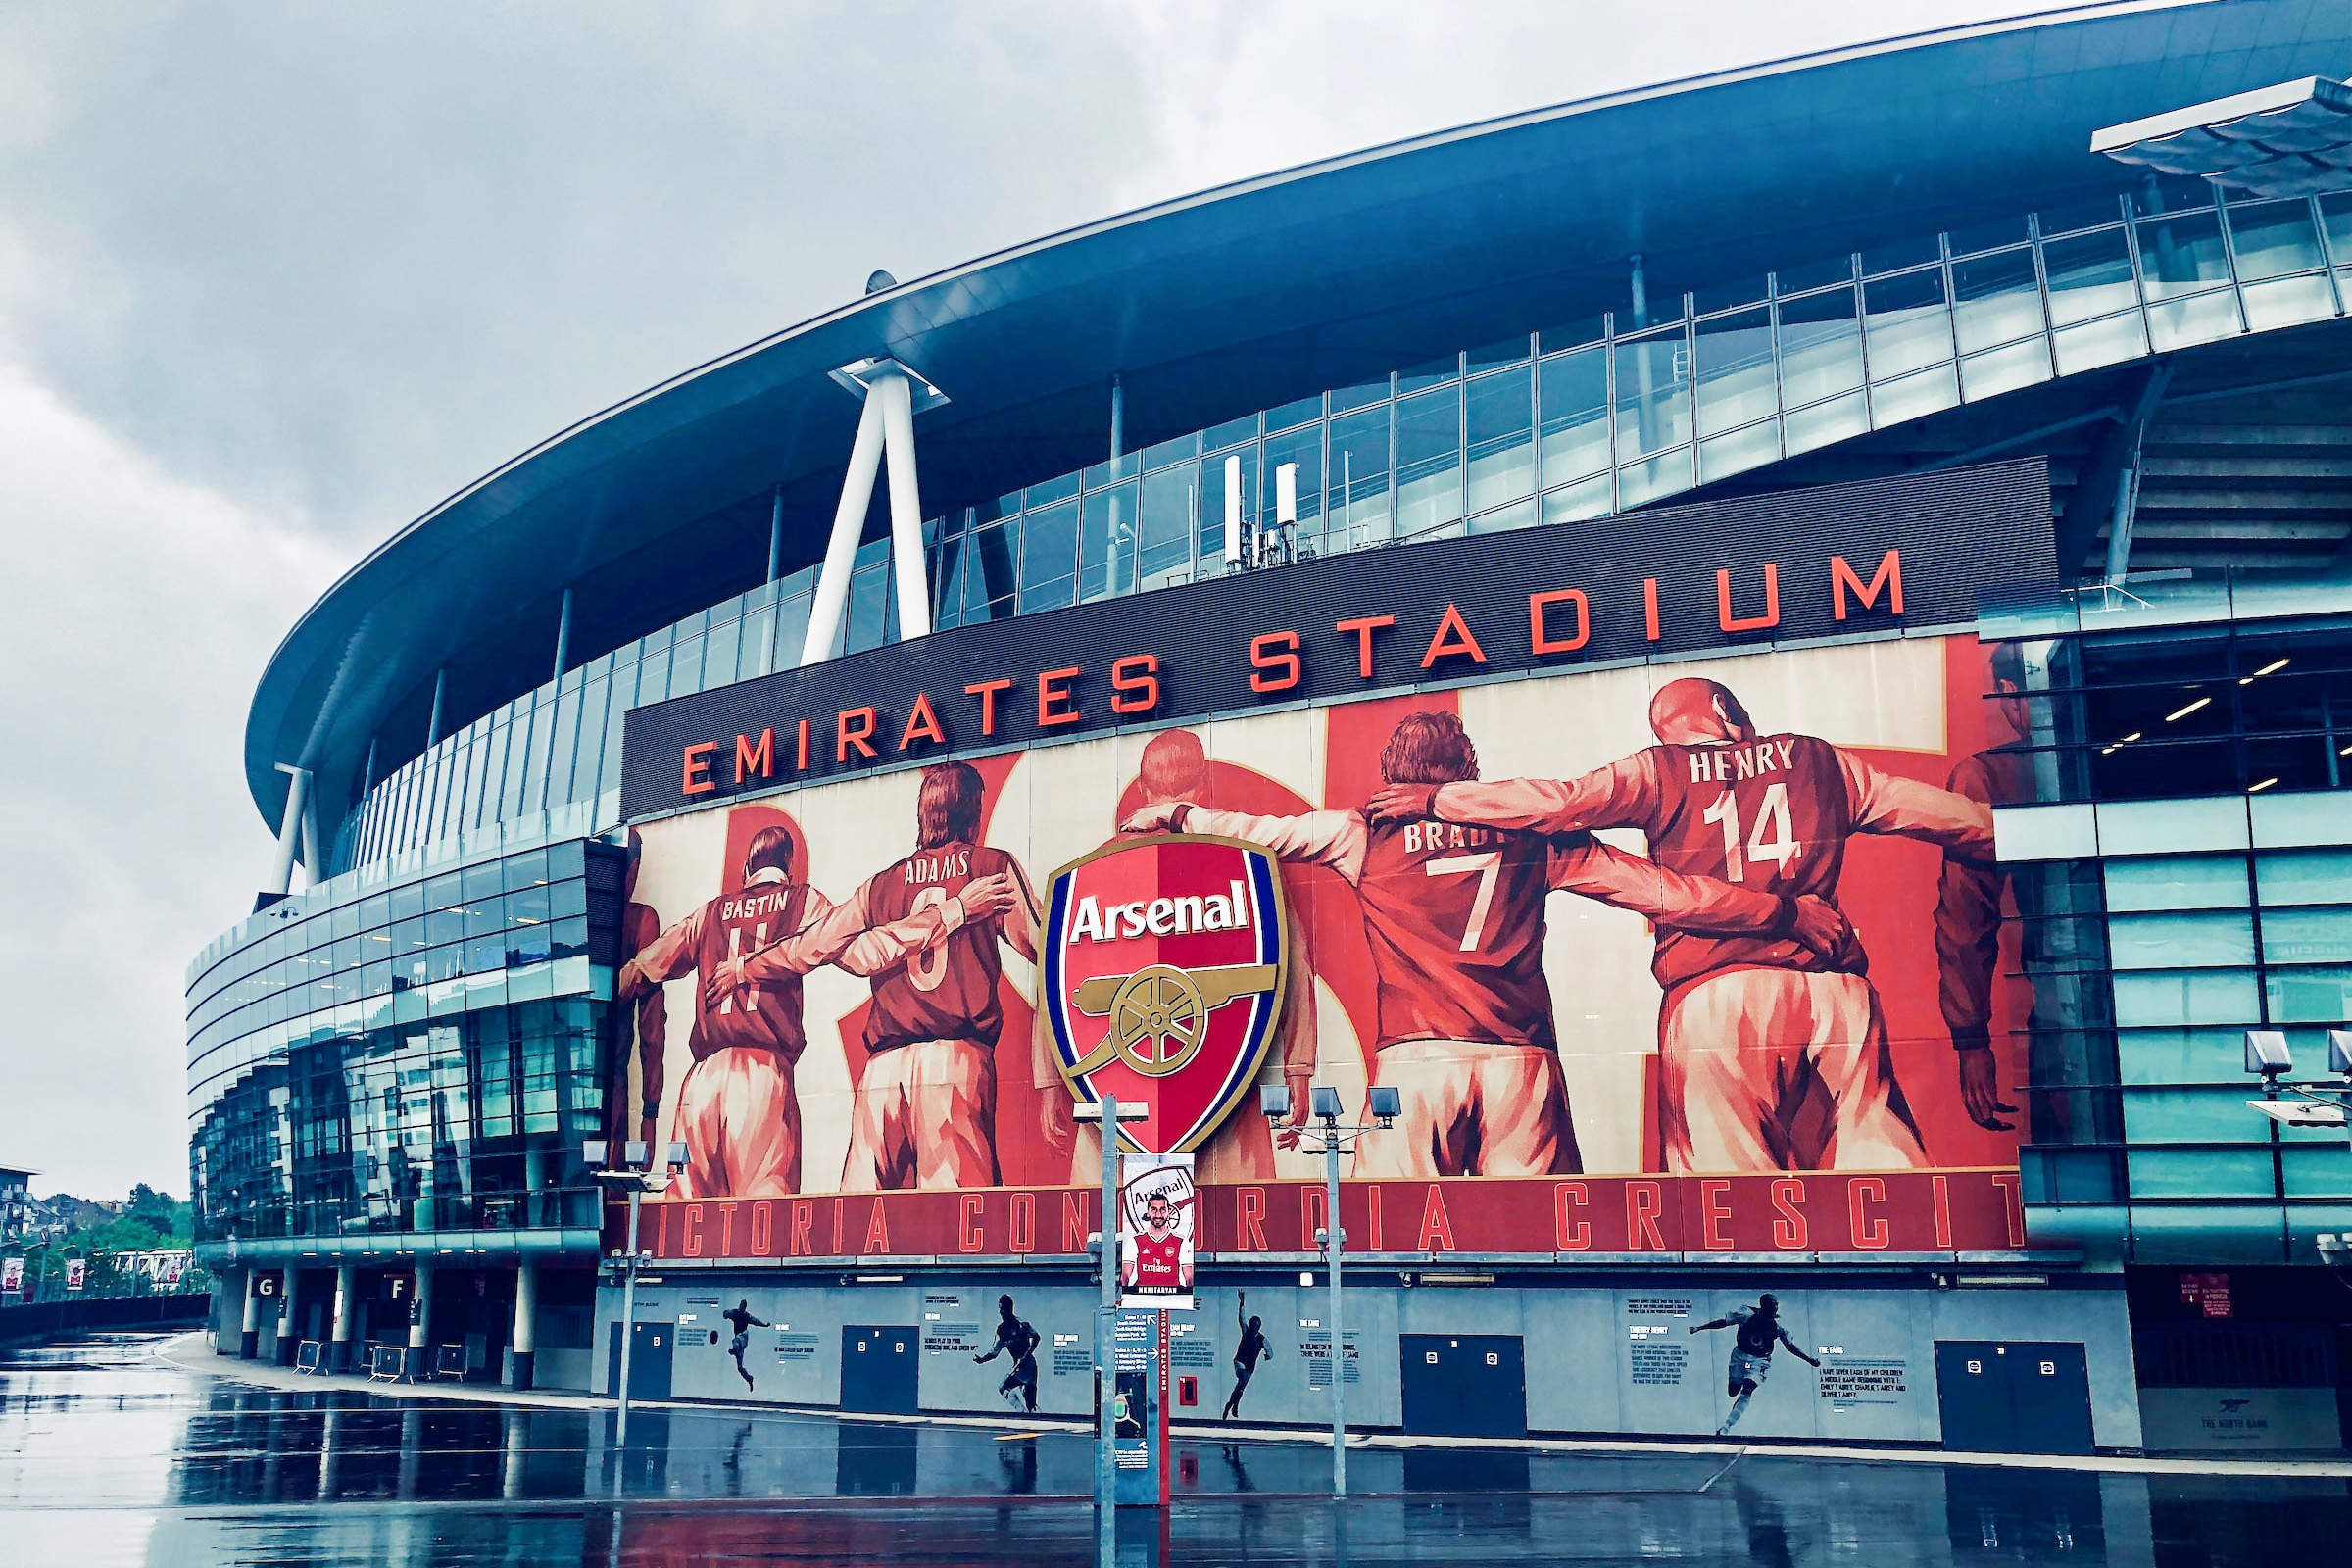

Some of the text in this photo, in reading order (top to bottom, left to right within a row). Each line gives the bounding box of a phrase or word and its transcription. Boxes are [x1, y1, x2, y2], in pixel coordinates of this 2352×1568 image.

[683, 550, 1904, 795] EMIRATES STADIUM
[1689, 739, 1796, 784] HENRY
[1403, 821, 1506, 854] BRAD
[1703, 782, 1802, 883] 14
[904, 850, 970, 886] ADAMS
[721, 890, 790, 921] BASTIN
[1068, 879, 1250, 944] Arsenal
[1426, 852, 1502, 952] 7
[1134, 1178, 1184, 1205] Arsenal
[624, 1174, 2025, 1258] ICTORIA CONRDIA CRESCIT
[1141, 1263, 1172, 1274] Emirates
[259, 1278, 273, 1296] G
[392, 1279, 404, 1298] F
